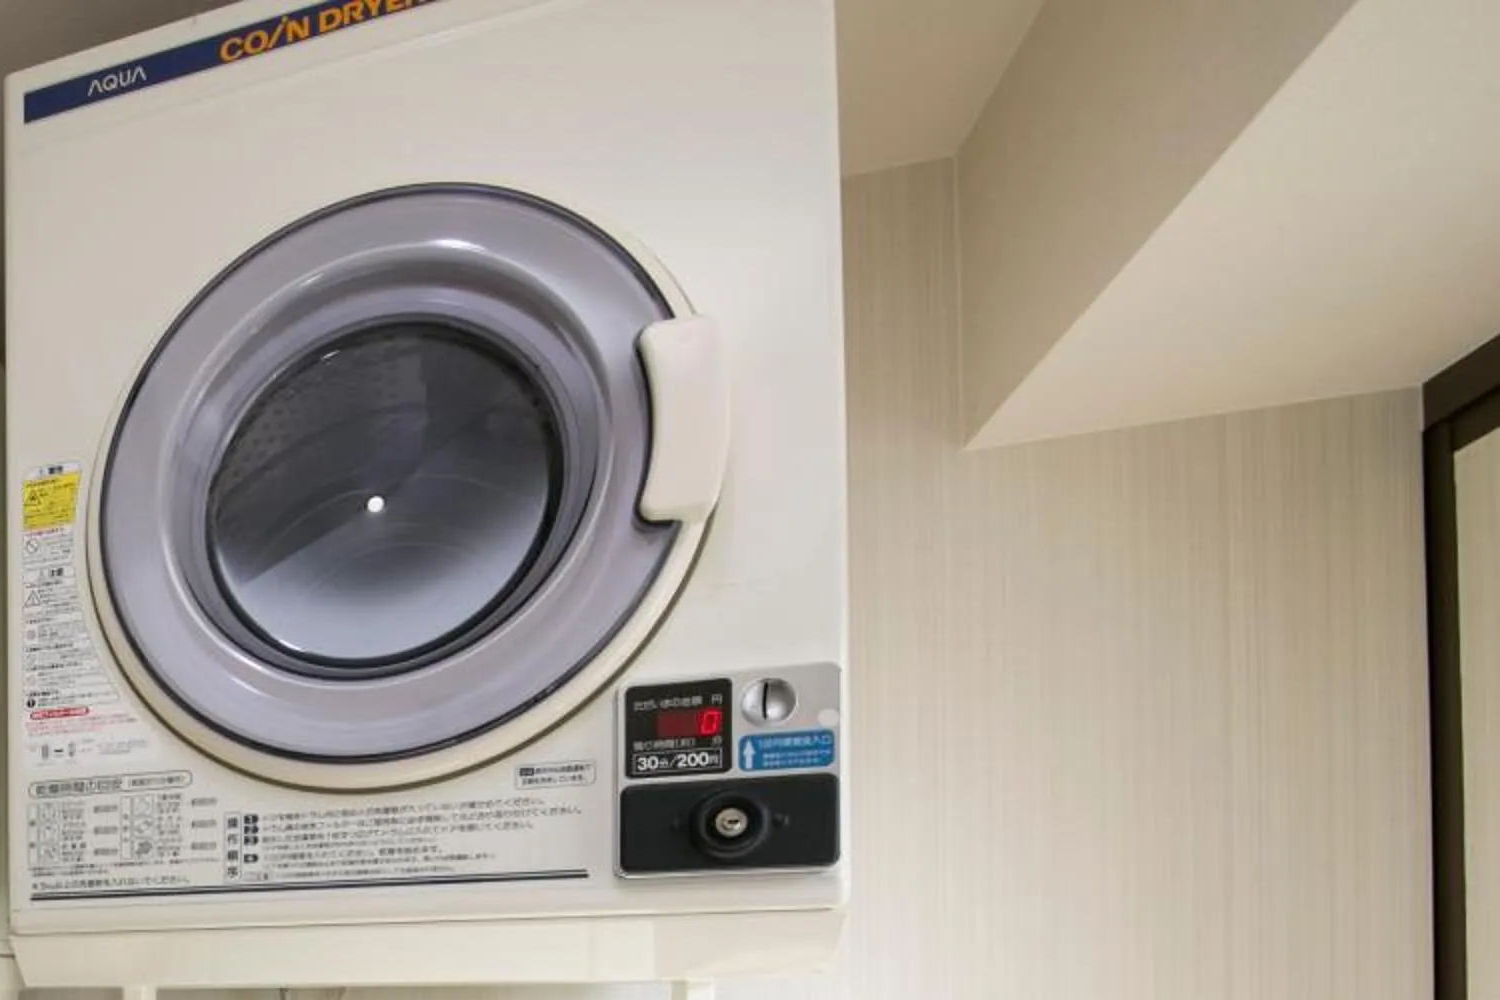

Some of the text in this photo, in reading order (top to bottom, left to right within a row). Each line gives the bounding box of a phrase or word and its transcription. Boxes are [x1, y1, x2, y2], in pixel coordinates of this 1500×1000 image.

[318, 0, 432, 34] DRYE
[87, 65, 147, 97] AQUA
[701, 711, 721, 733] 0
